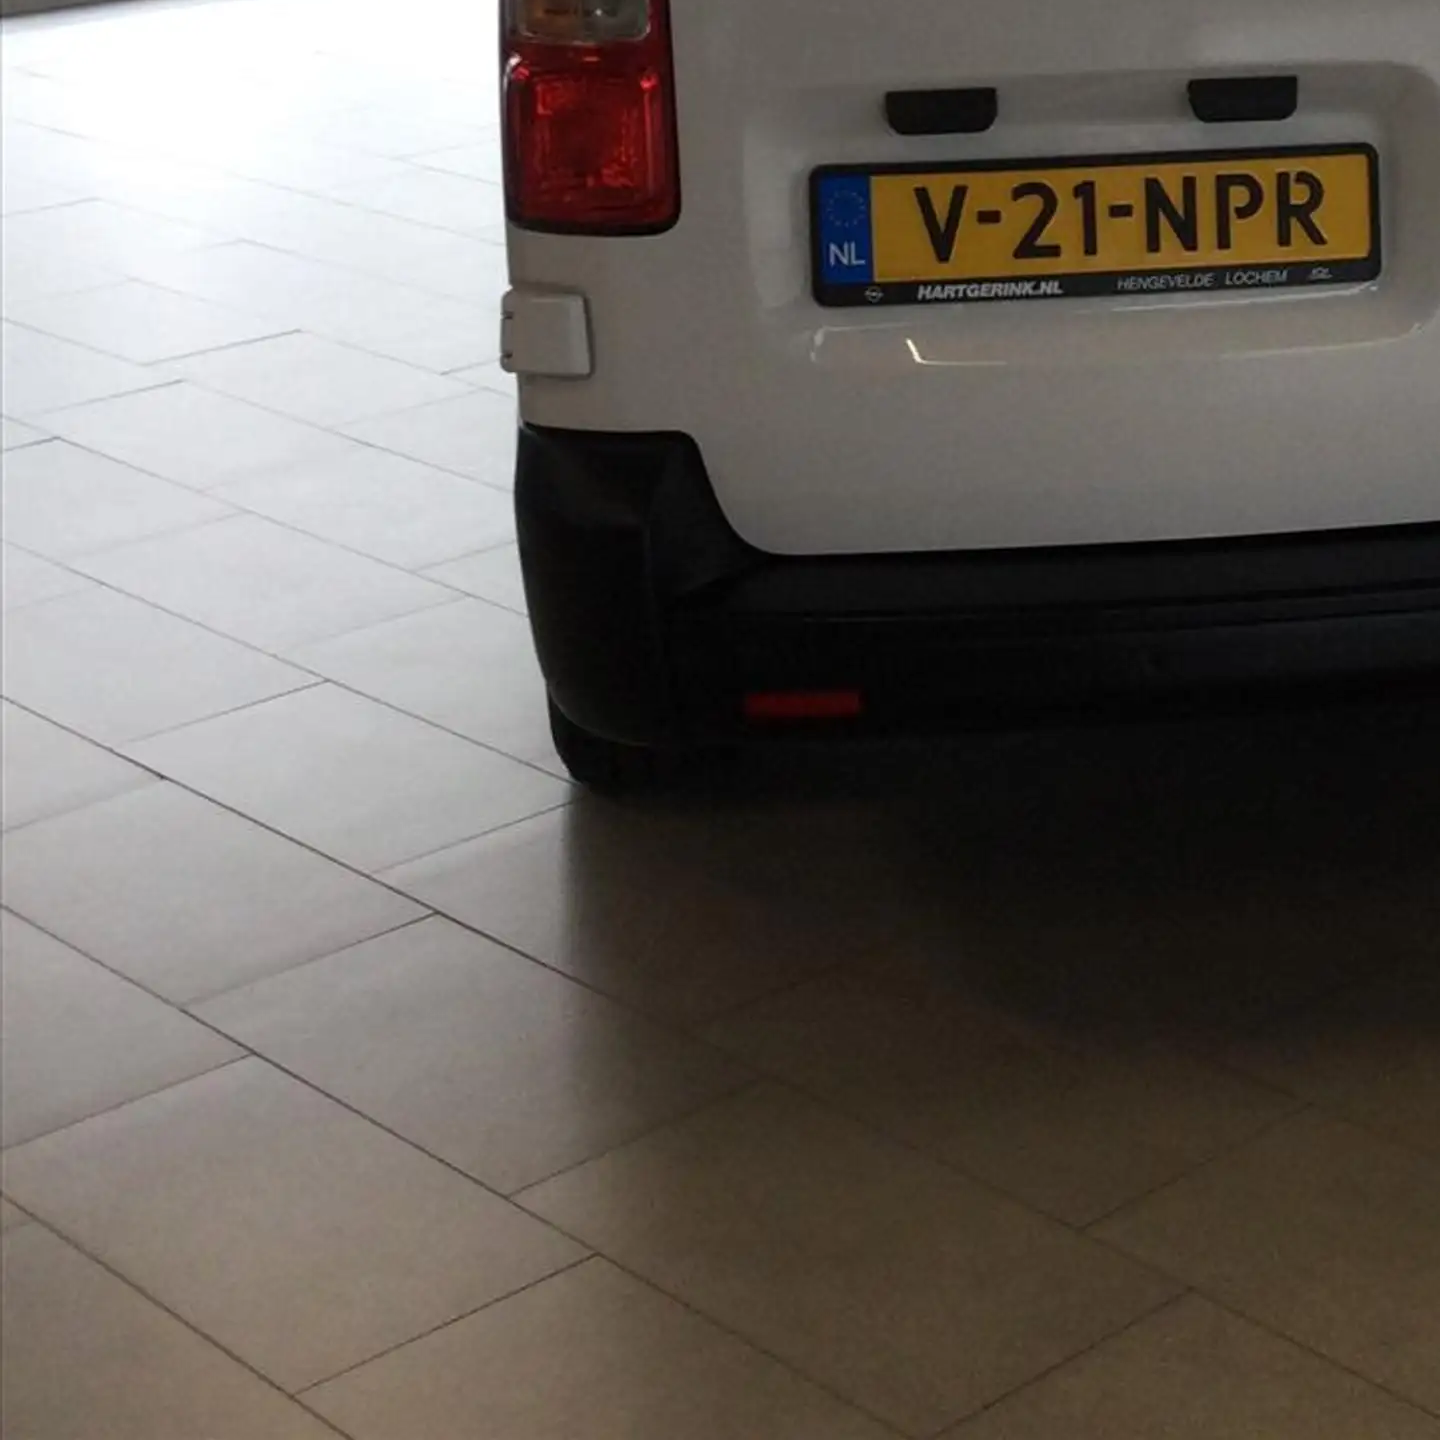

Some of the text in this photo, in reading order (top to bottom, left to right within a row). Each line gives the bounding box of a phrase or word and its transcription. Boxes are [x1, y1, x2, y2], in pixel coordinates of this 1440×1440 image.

[914, 169, 1329, 265] V-21-NPR
[829, 240, 866, 267] NL
[917, 280, 1063, 300] HARTGERINK.NL
[1117, 272, 1215, 291] HENGEVELDE
[1225, 269, 1289, 286] LOCHEM
